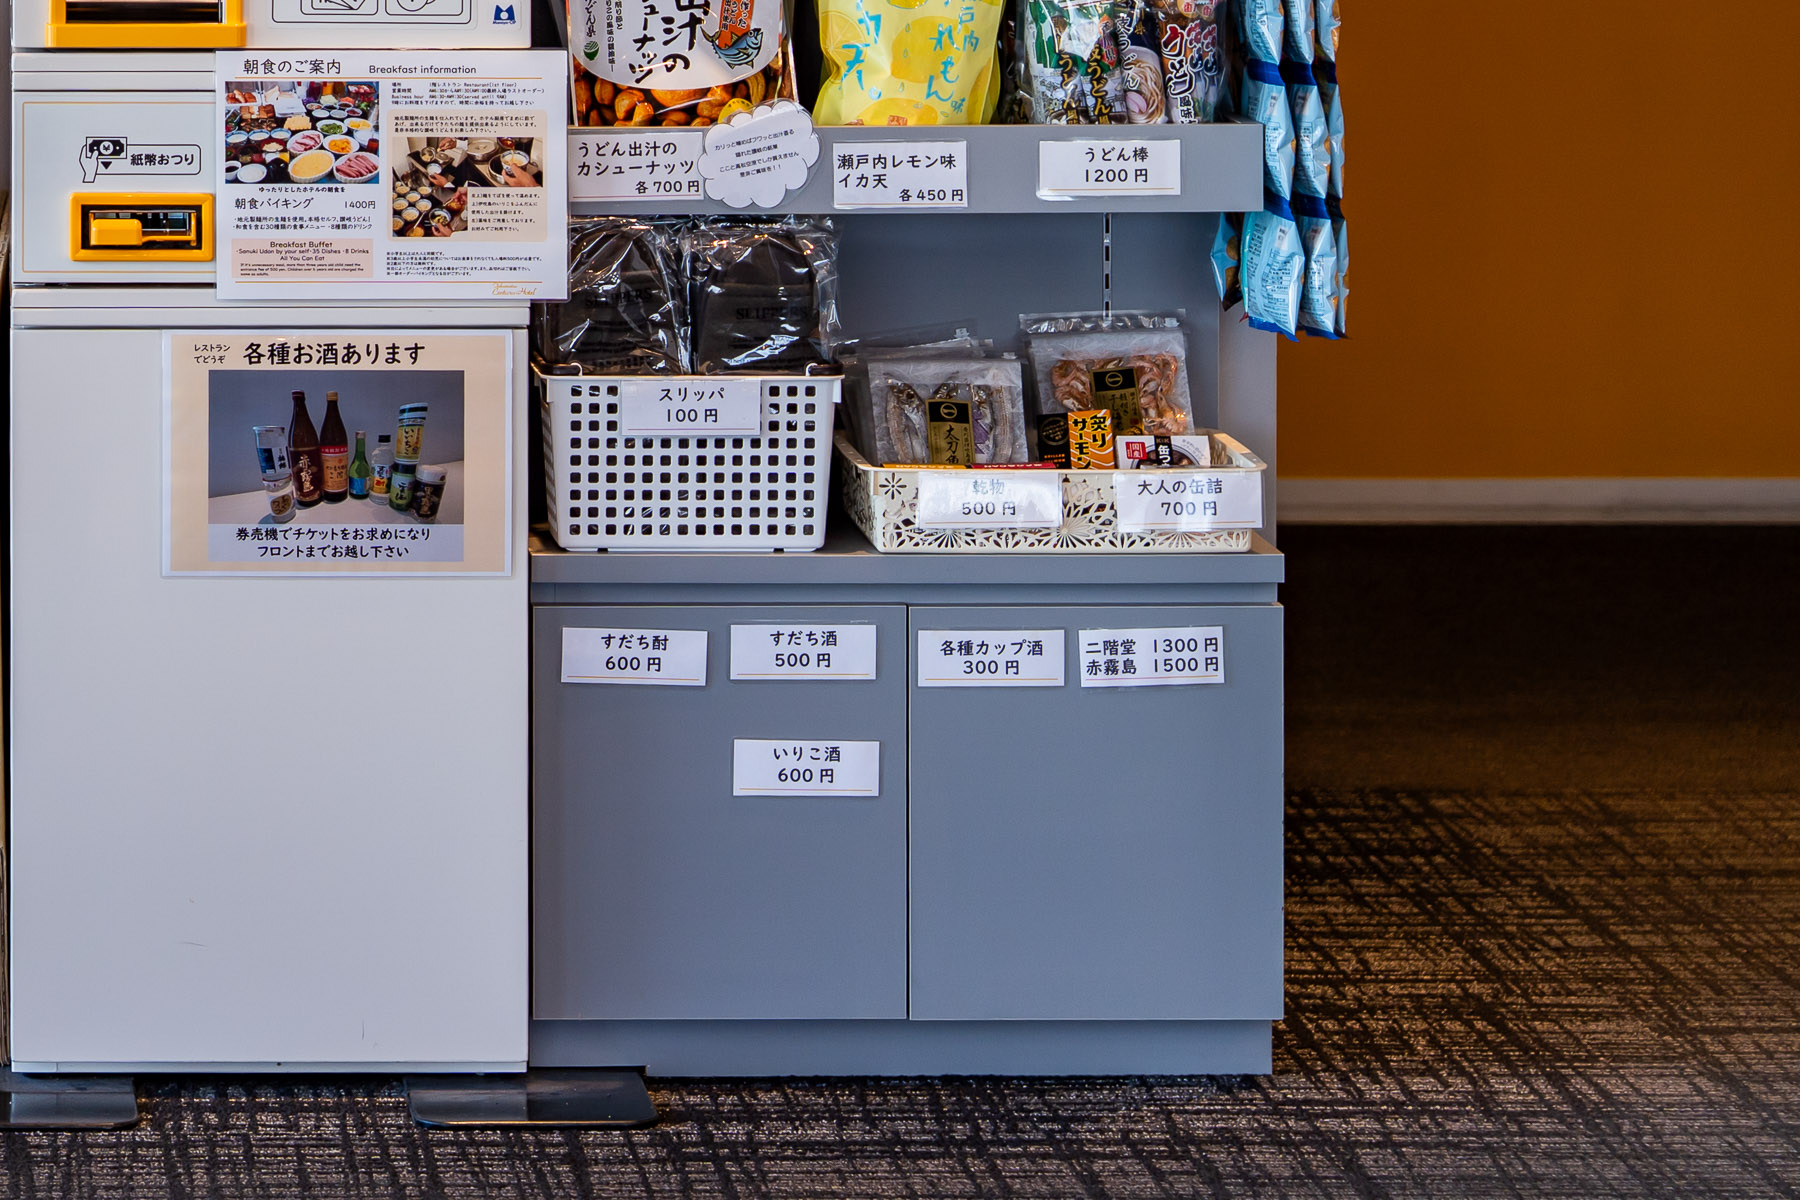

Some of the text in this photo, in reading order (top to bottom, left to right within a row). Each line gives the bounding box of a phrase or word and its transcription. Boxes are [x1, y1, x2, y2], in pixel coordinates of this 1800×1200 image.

[243, 58, 342, 75] 朝食のご案内
[369, 65, 476, 74] Breakfast information
[578, 141, 677, 158] うどん出汁の
[1084, 147, 1149, 162] うどん棒
[130, 152, 195, 167] 紙幣おつり
[837, 154, 956, 170] 瀬戸内レモン味
[578, 161, 695, 176] カシューナッツ
[1083, 169, 1148, 183] 1200 円
[636, 180, 700, 194] 各 700 円
[838, 174, 888, 189] イカ天
[899, 188, 963, 202] 各 450 円
[235, 197, 314, 209] 朝食バイキング
[194, 344, 230, 352] レストラン
[243, 342, 425, 366] 各種お酒あります
[194, 355, 225, 364] でどうぞ
[659, 387, 725, 401] スリッパ
[667, 408, 718, 422] 100 円
[1138, 478, 1222, 496] 大人の缶詰
[1161, 501, 1217, 516] 700 円
[236, 527, 431, 542] 券売機でチケットをお求めになり
[257, 545, 409, 559] フロントまでお越し下さい
[601, 634, 669, 652] すだち酎
[769, 630, 838, 648] すだち酒
[1087, 637, 1218, 656] 二階堂 1300 円
[940, 639, 1043, 657] 各種カップ酒
[605, 656, 661, 672] 600 円
[775, 653, 831, 668] 500 円
[963, 660, 1020, 676] 300 円
[1087, 657, 1218, 676] 赤霧島 1500 円
[773, 746, 841, 763] いりこ酒
[777, 768, 834, 784] 600 円
